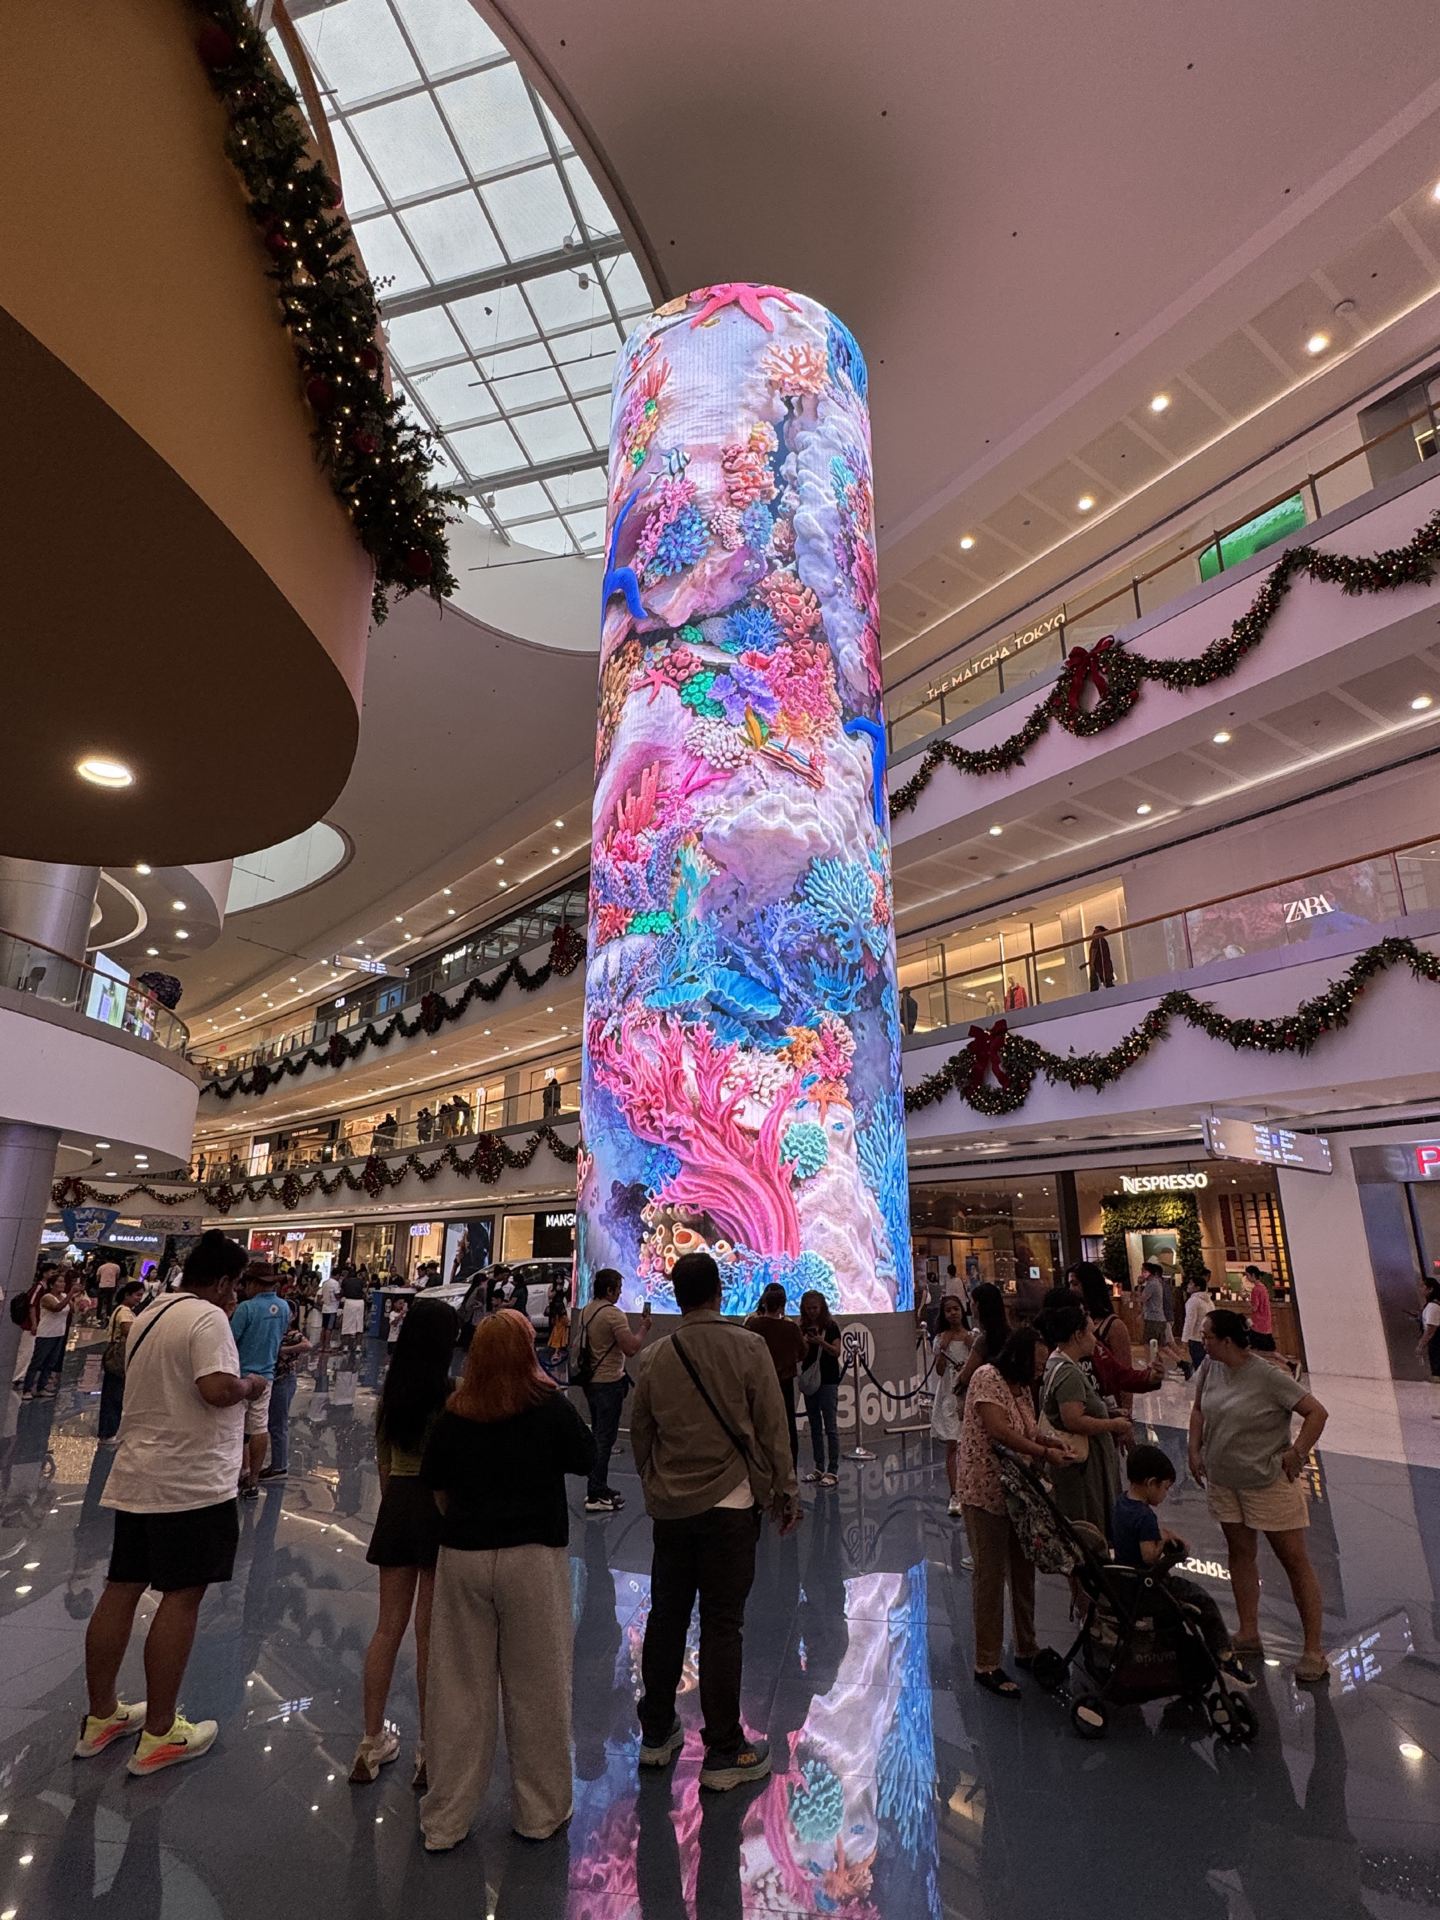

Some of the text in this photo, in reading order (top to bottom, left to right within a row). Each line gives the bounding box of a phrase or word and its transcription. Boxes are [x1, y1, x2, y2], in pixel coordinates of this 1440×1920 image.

[951, 647, 1010, 686] MATCHA
[1015, 613, 1066, 649] TOKYO
[1283, 894, 1335, 923] ZARA
[1119, 1172, 1208, 1194] NESPRESSO
[410, 1223, 431, 1237] GUESS
[545, 1213, 577, 1228] MANG
